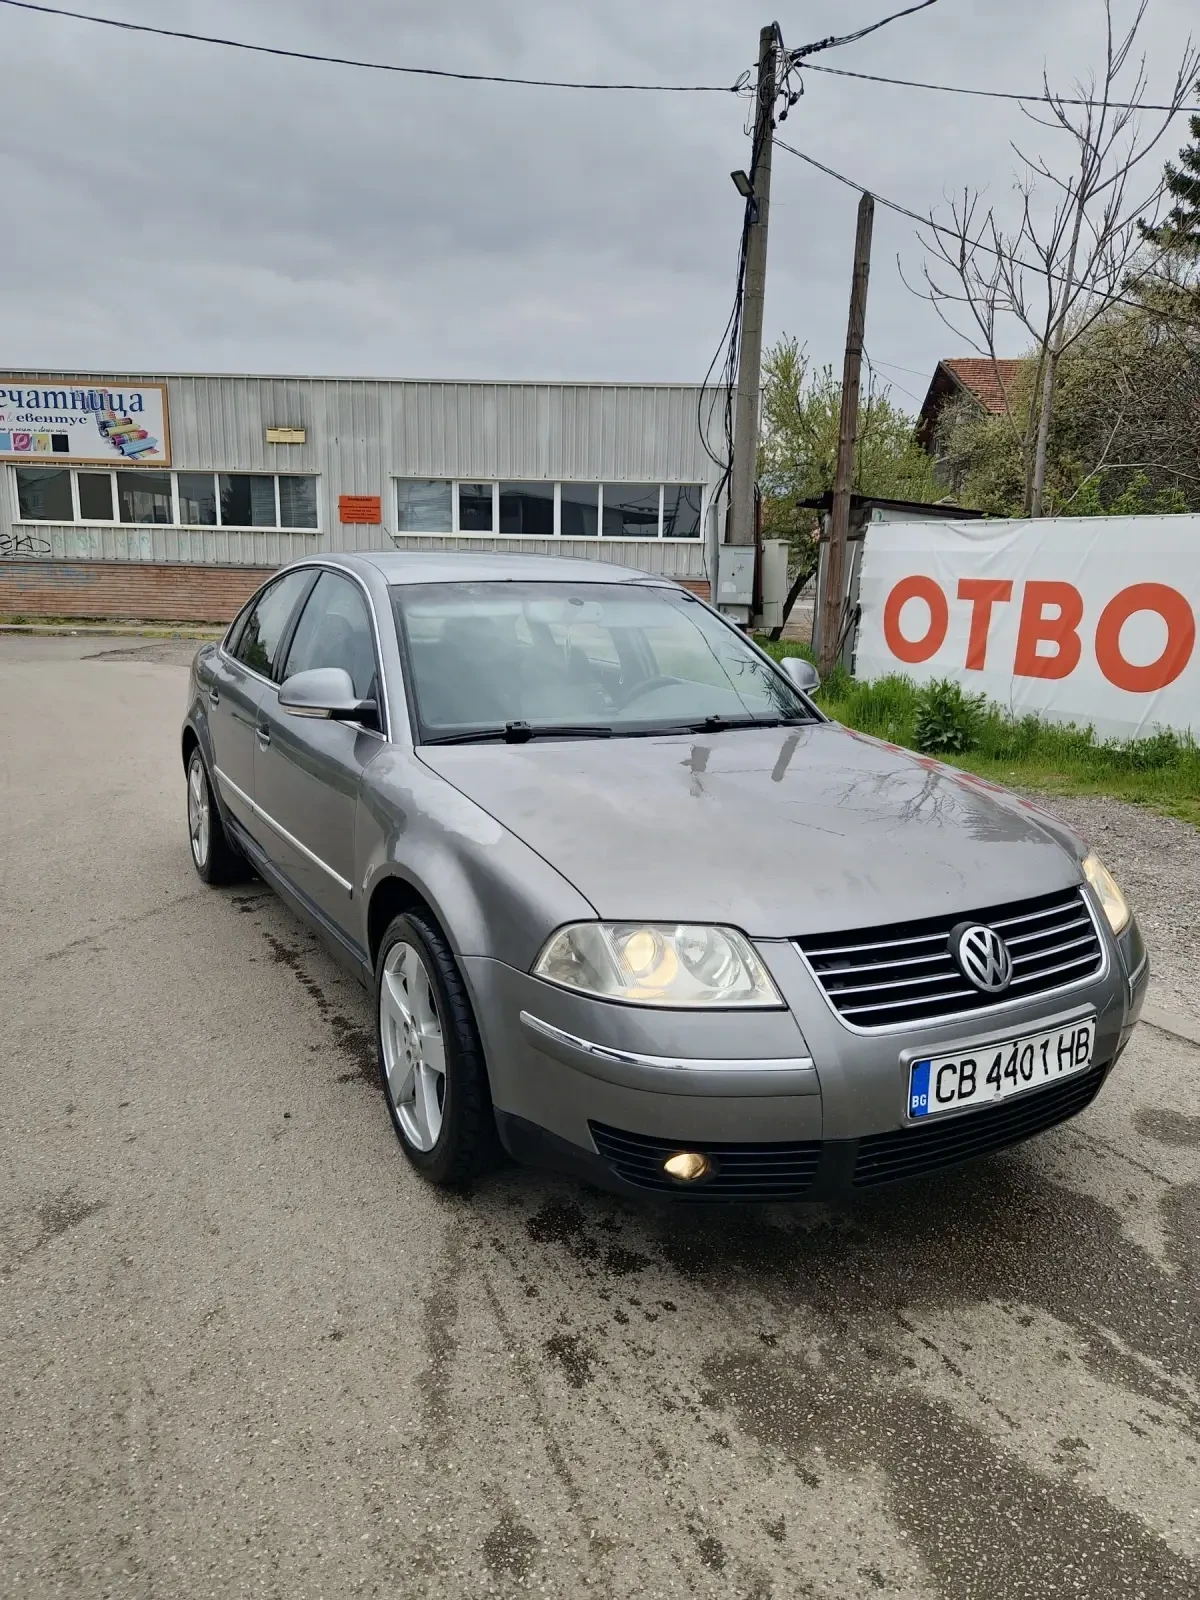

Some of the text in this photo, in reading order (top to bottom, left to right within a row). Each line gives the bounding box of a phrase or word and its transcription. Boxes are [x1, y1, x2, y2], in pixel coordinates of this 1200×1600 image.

[16, 412, 87, 426] евентус
[884, 575, 1196, 693] ОТВО
[935, 1027, 1090, 1104] CB 4401 HB
[911, 1094, 927, 1109] BG
